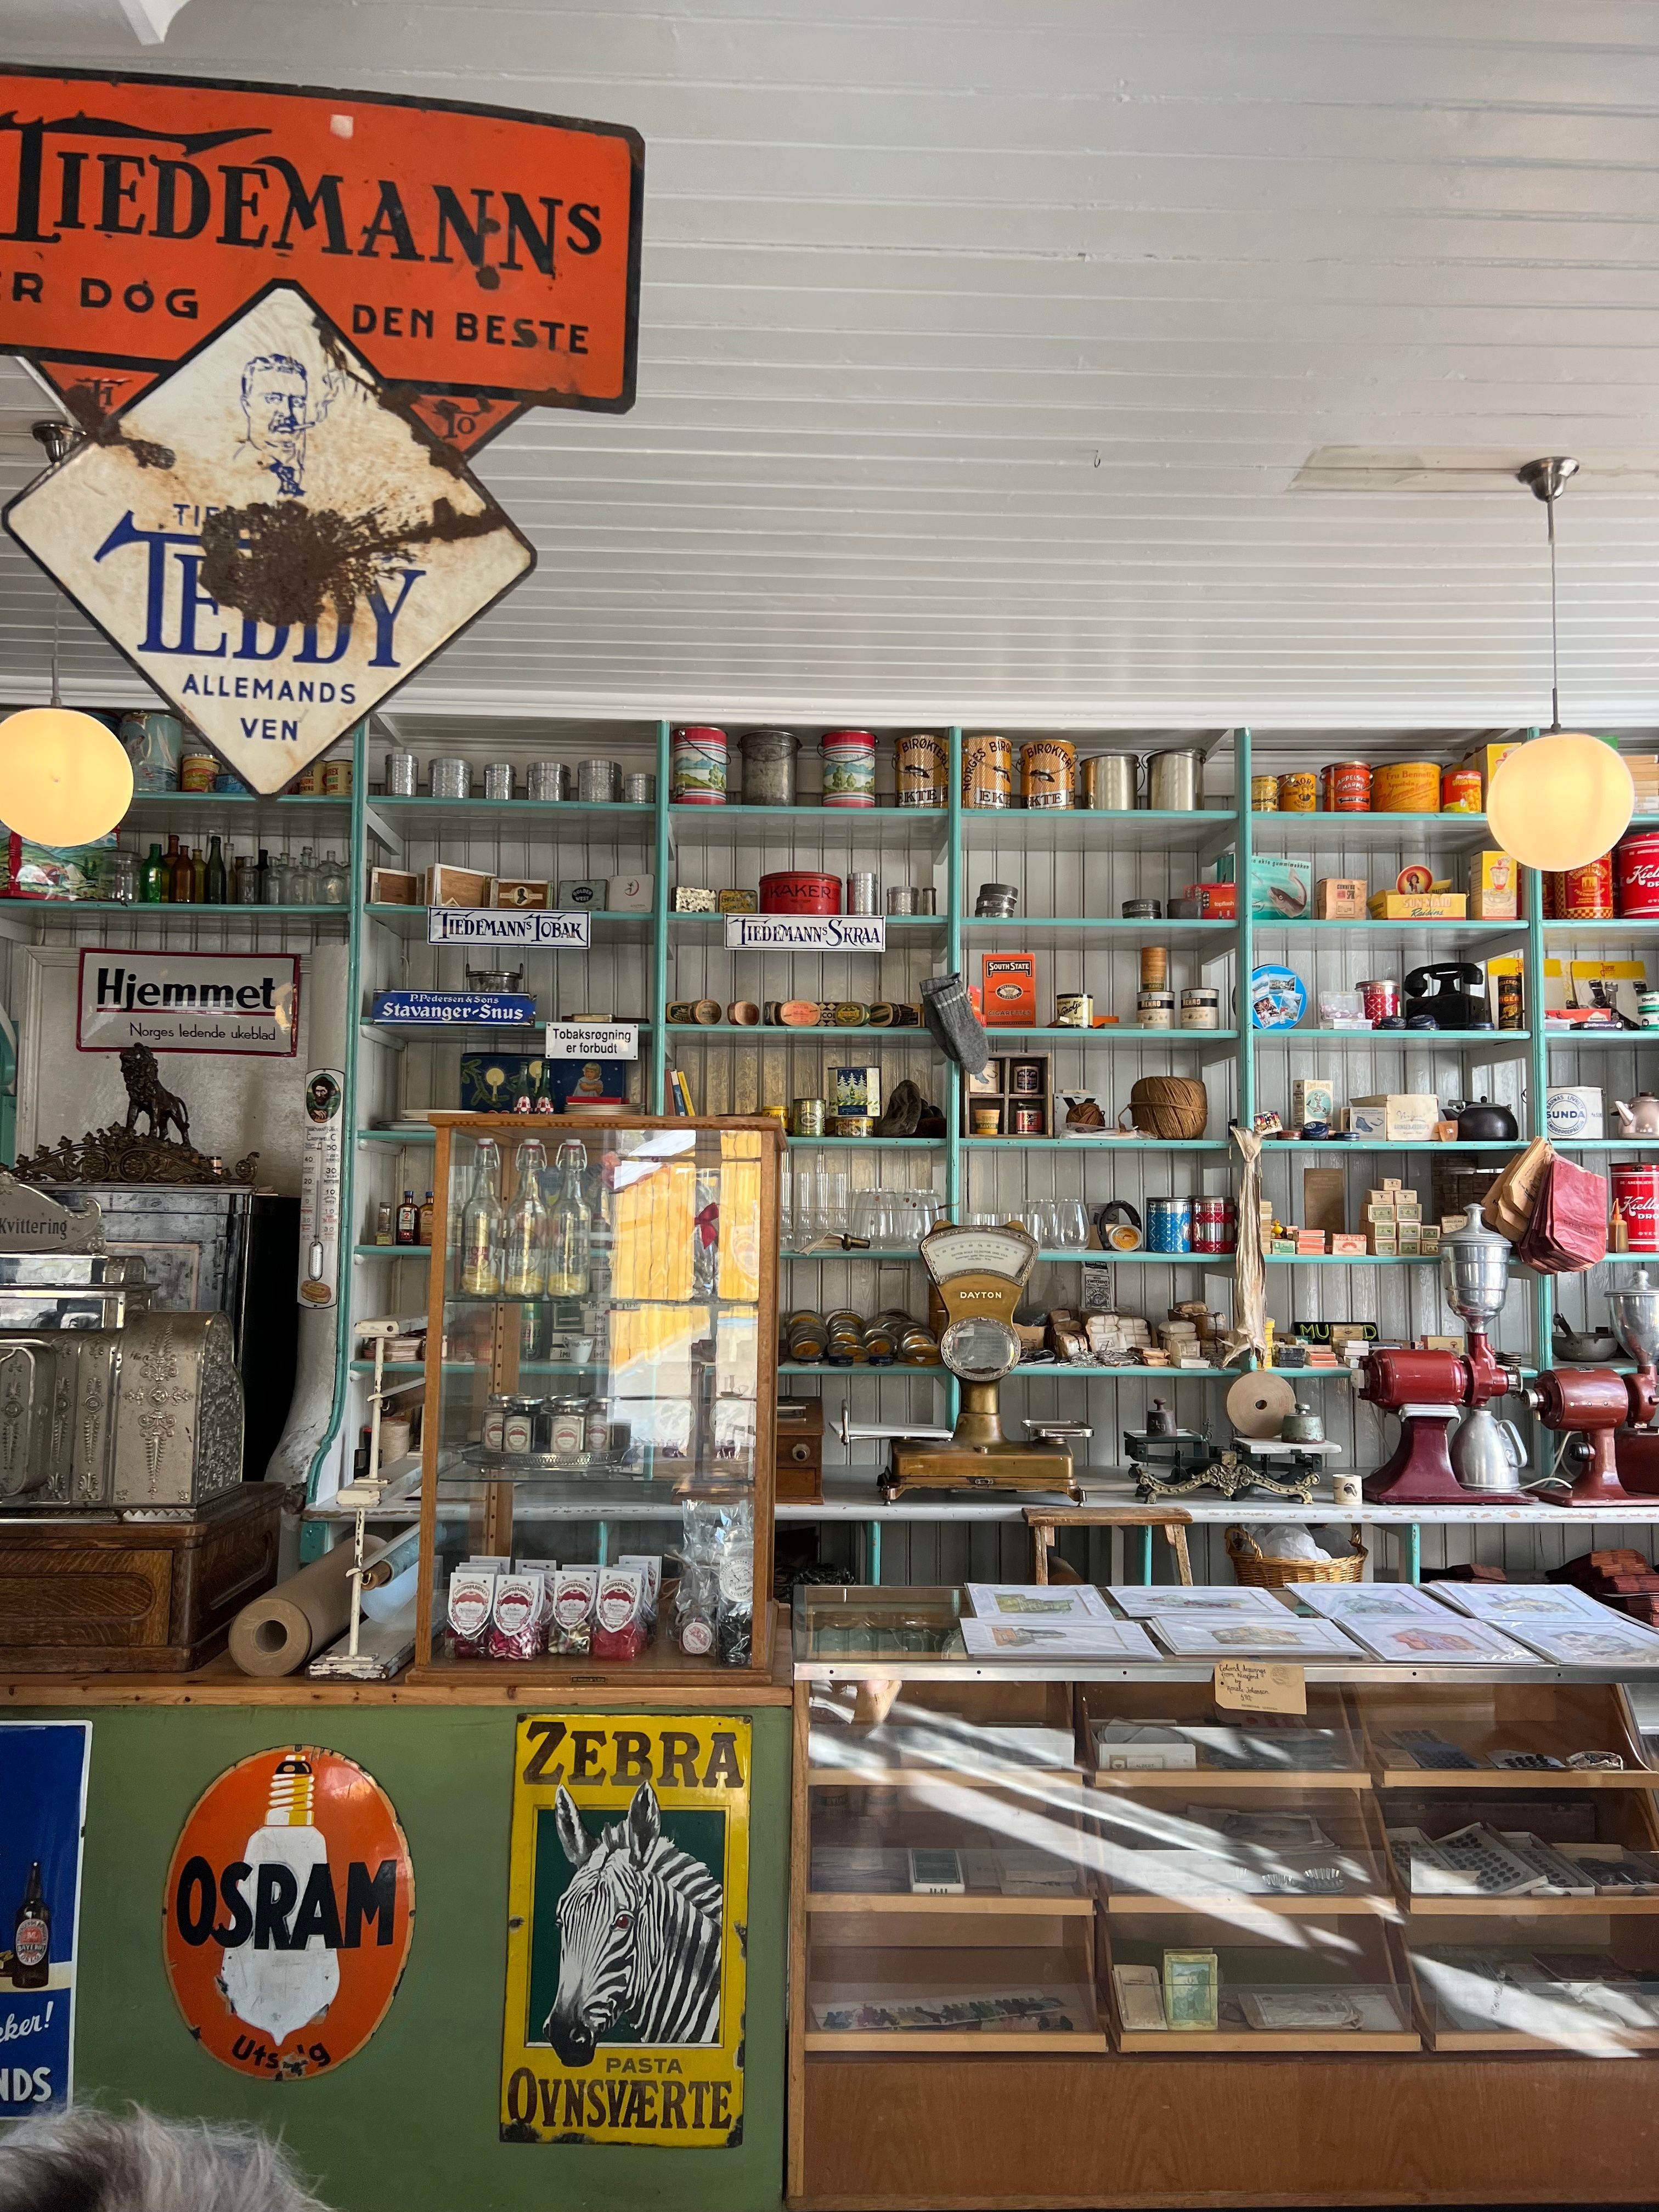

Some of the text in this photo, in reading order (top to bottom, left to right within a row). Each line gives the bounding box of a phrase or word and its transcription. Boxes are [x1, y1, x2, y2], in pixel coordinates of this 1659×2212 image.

[353, 304, 434, 338] DEN
[456, 313, 589, 354] BESTE
[183, 674, 356, 704] ALLEMANDS
[240, 717, 298, 741] VEN
[770, 884, 833, 900] KAKER
[1410, 907, 1444, 917] Raisins
[526, 913, 586, 942] TOBAK
[826, 918, 882, 947] SKRAA
[989, 962, 1030, 971] SOUTH STATE
[97, 967, 276, 1012] Hjemmet
[465, 996, 473, 1004] &
[474, 995, 499, 1005] Sons
[382, 1002, 524, 1021] Stavanger-Snus
[129, 1022, 276, 1041] Norges ledende ukeblad
[552, 1028, 631, 1042] Tobaksrøgning
[566, 1042, 618, 1054] er forbudt
[1547, 1110, 1585, 1119] SUNDA
[0, 1217, 67, 1240] Kvittering
[960, 1291, 1002, 1299] DAYTON
[1219, 1663, 1240, 1672] Colored
[1234, 1678, 1242, 1686] by
[522, 1720, 745, 1788] ZEBRA
[176, 1855, 397, 1950] OSRAM
[0, 2001, 54, 2044] ker!
[232, 2033, 331, 2069] Utsg
[605, 2058, 683, 2074] PASTA
